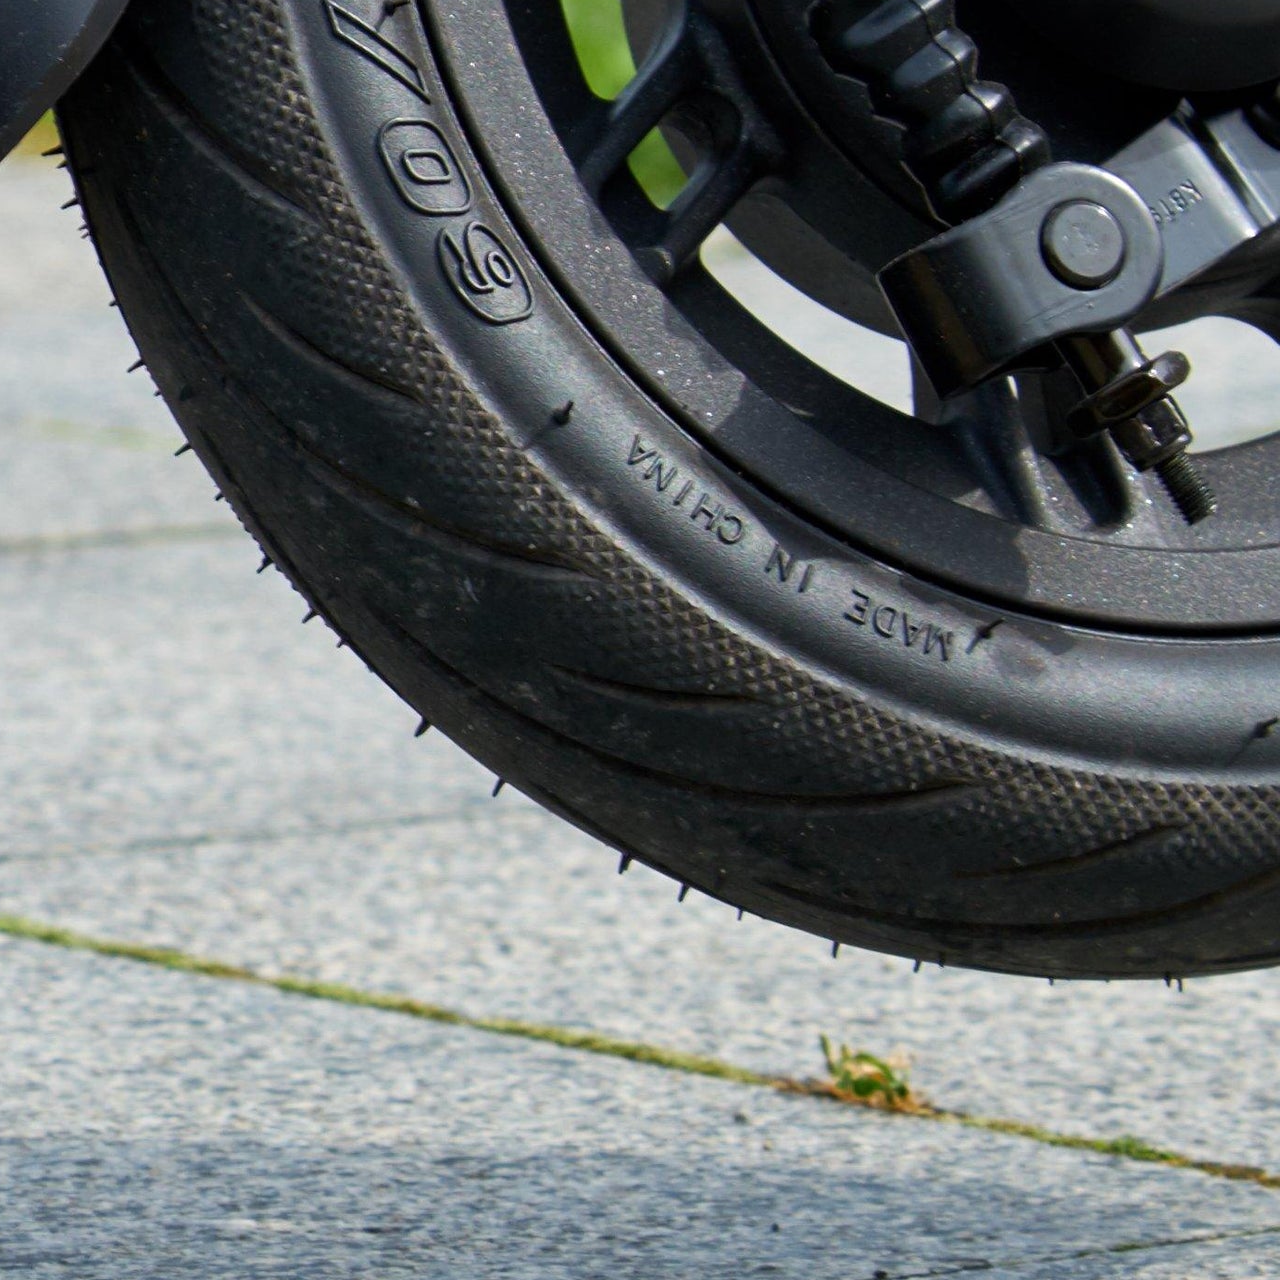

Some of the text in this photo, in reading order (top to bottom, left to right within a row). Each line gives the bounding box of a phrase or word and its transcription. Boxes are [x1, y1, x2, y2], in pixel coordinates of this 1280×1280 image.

[626, 433, 954, 662] MADE IN CHINA
